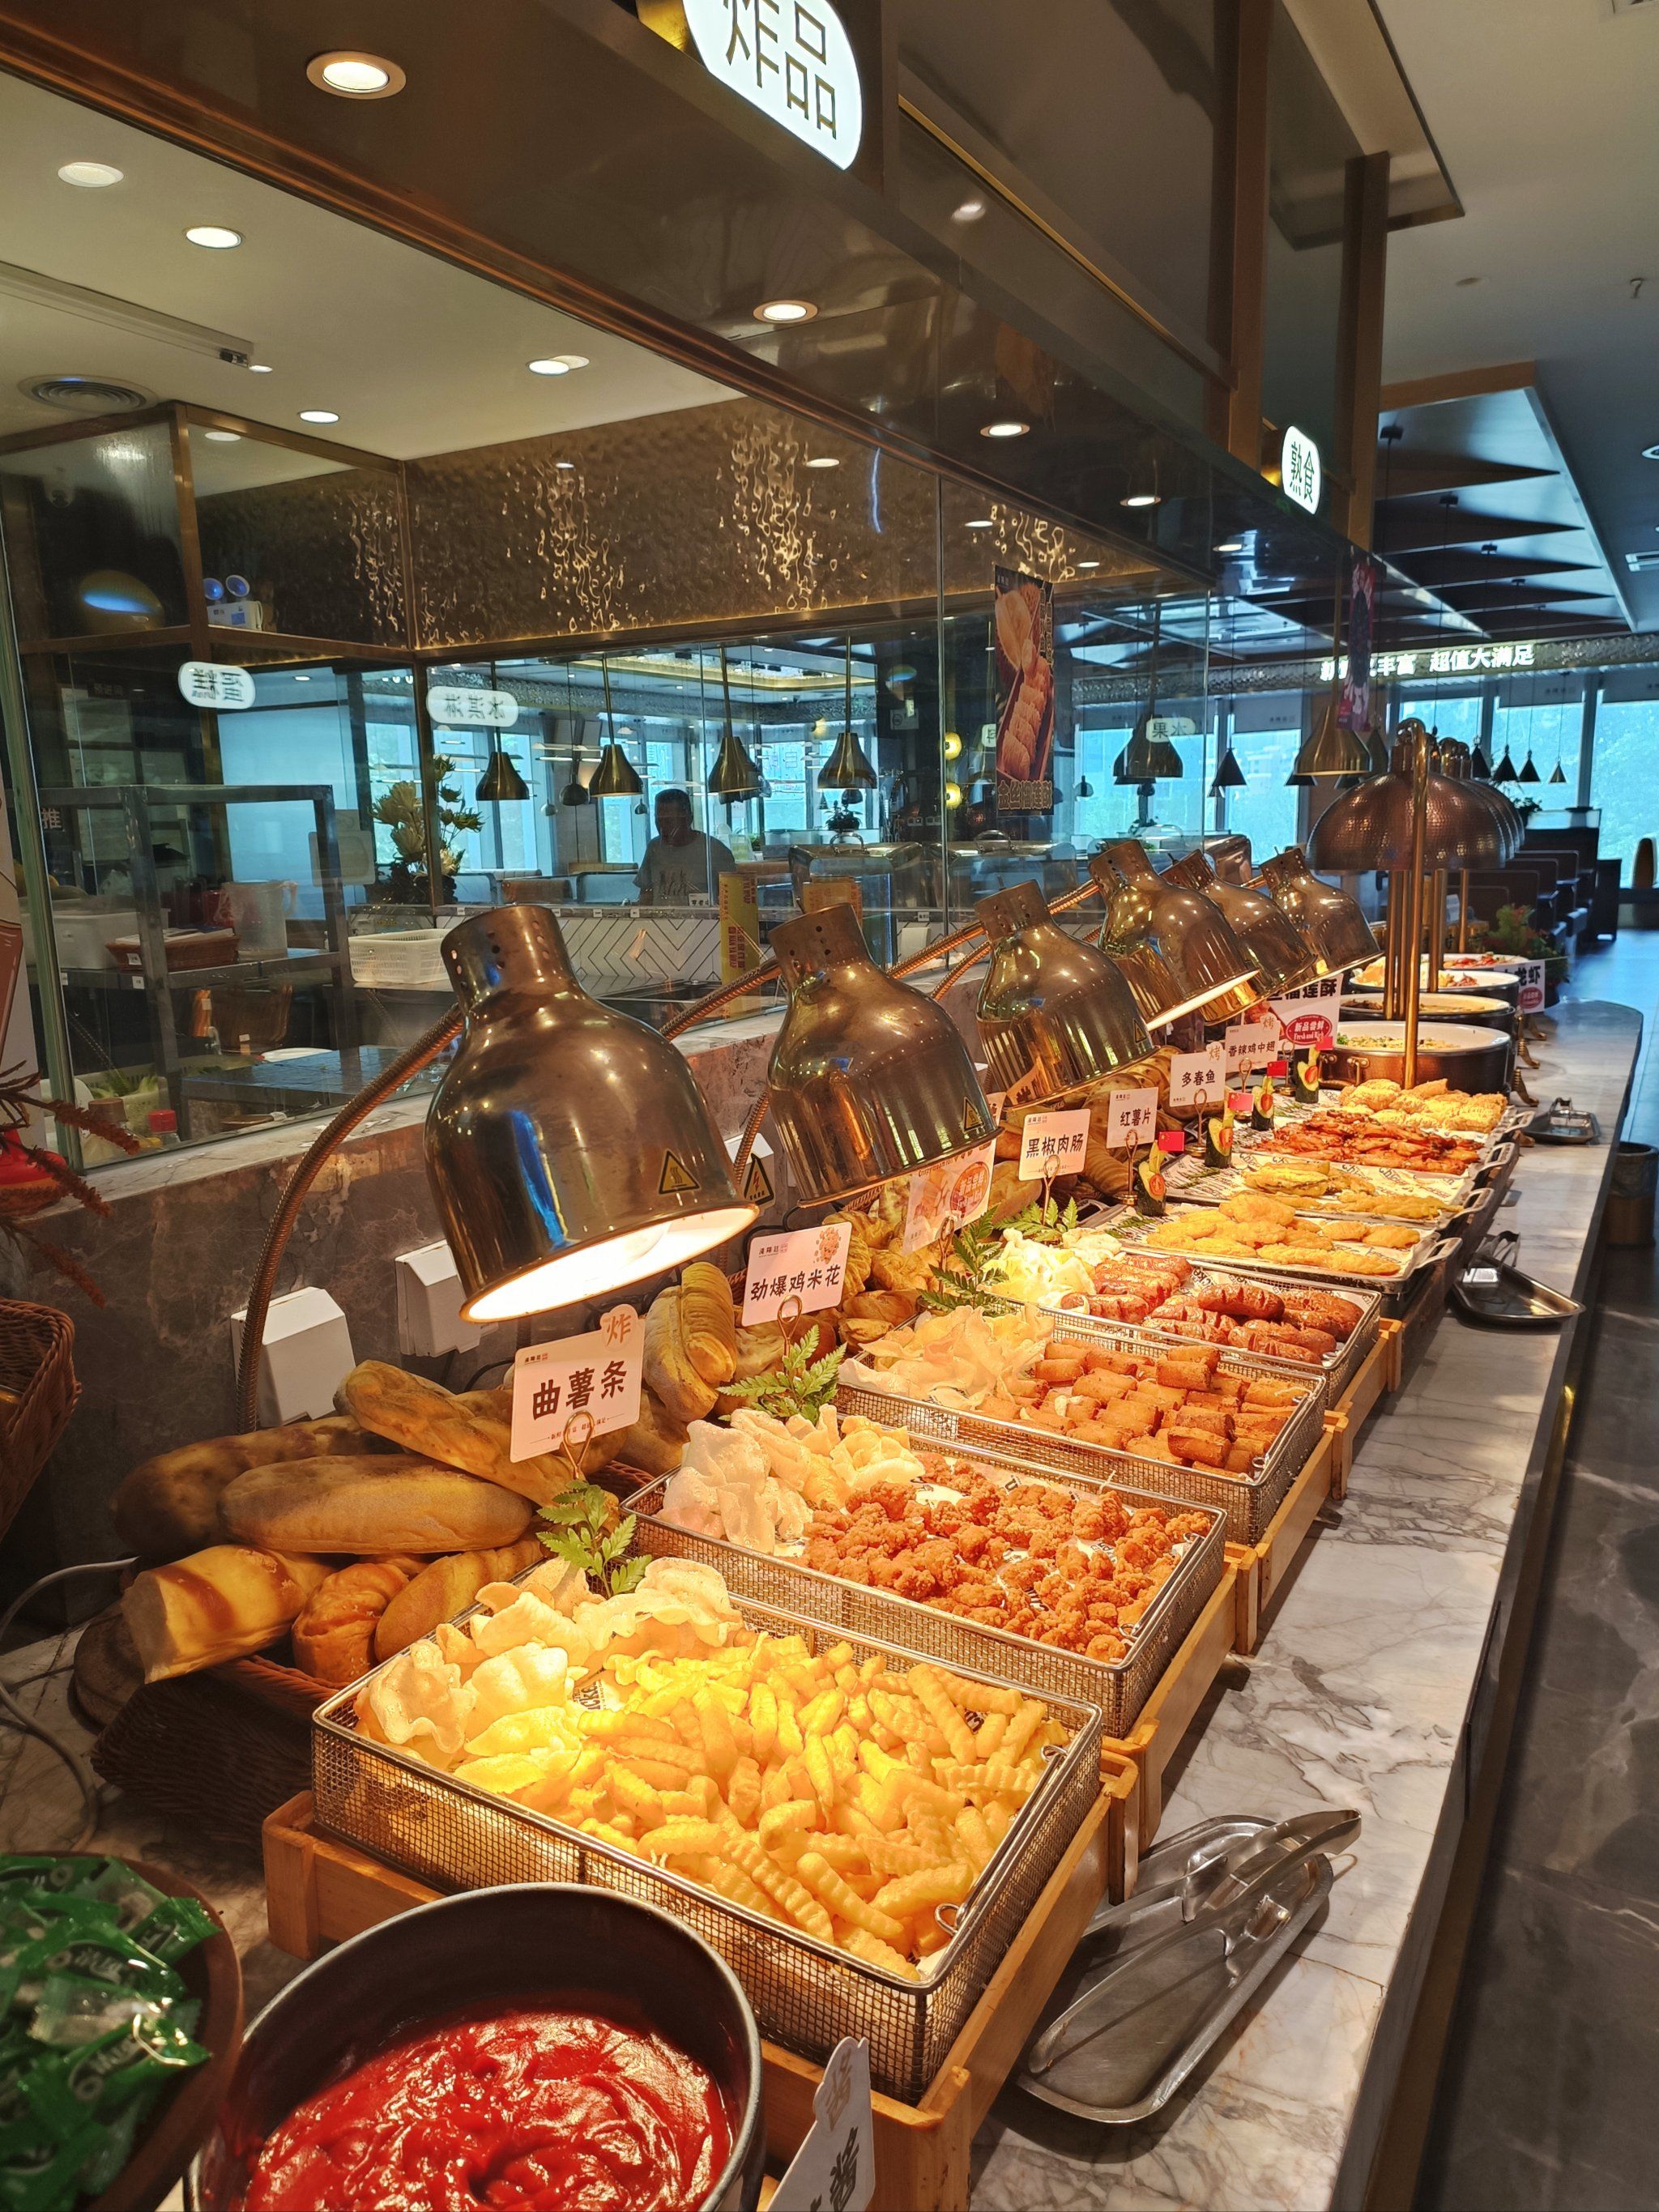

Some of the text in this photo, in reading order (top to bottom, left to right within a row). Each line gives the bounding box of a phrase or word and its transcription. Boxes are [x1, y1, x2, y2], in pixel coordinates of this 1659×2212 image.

[722, 0, 837, 140] 炸品
[1290, 441, 1315, 503] 熟食
[1429, 645, 1534, 673] 超值大满足
[1228, 1041, 1275, 1057] 香辣鸡中翅
[1182, 1069, 1215, 1088] 多春鱼
[1120, 1107, 1151, 1127] 红薯片
[1026, 1133, 1084, 1158] 黑椒肉肠
[750, 1264, 841, 1302] 劲爆鸡米花
[606, 1314, 632, 1346] 炸
[532, 1360, 627, 1420] 曲薯条
